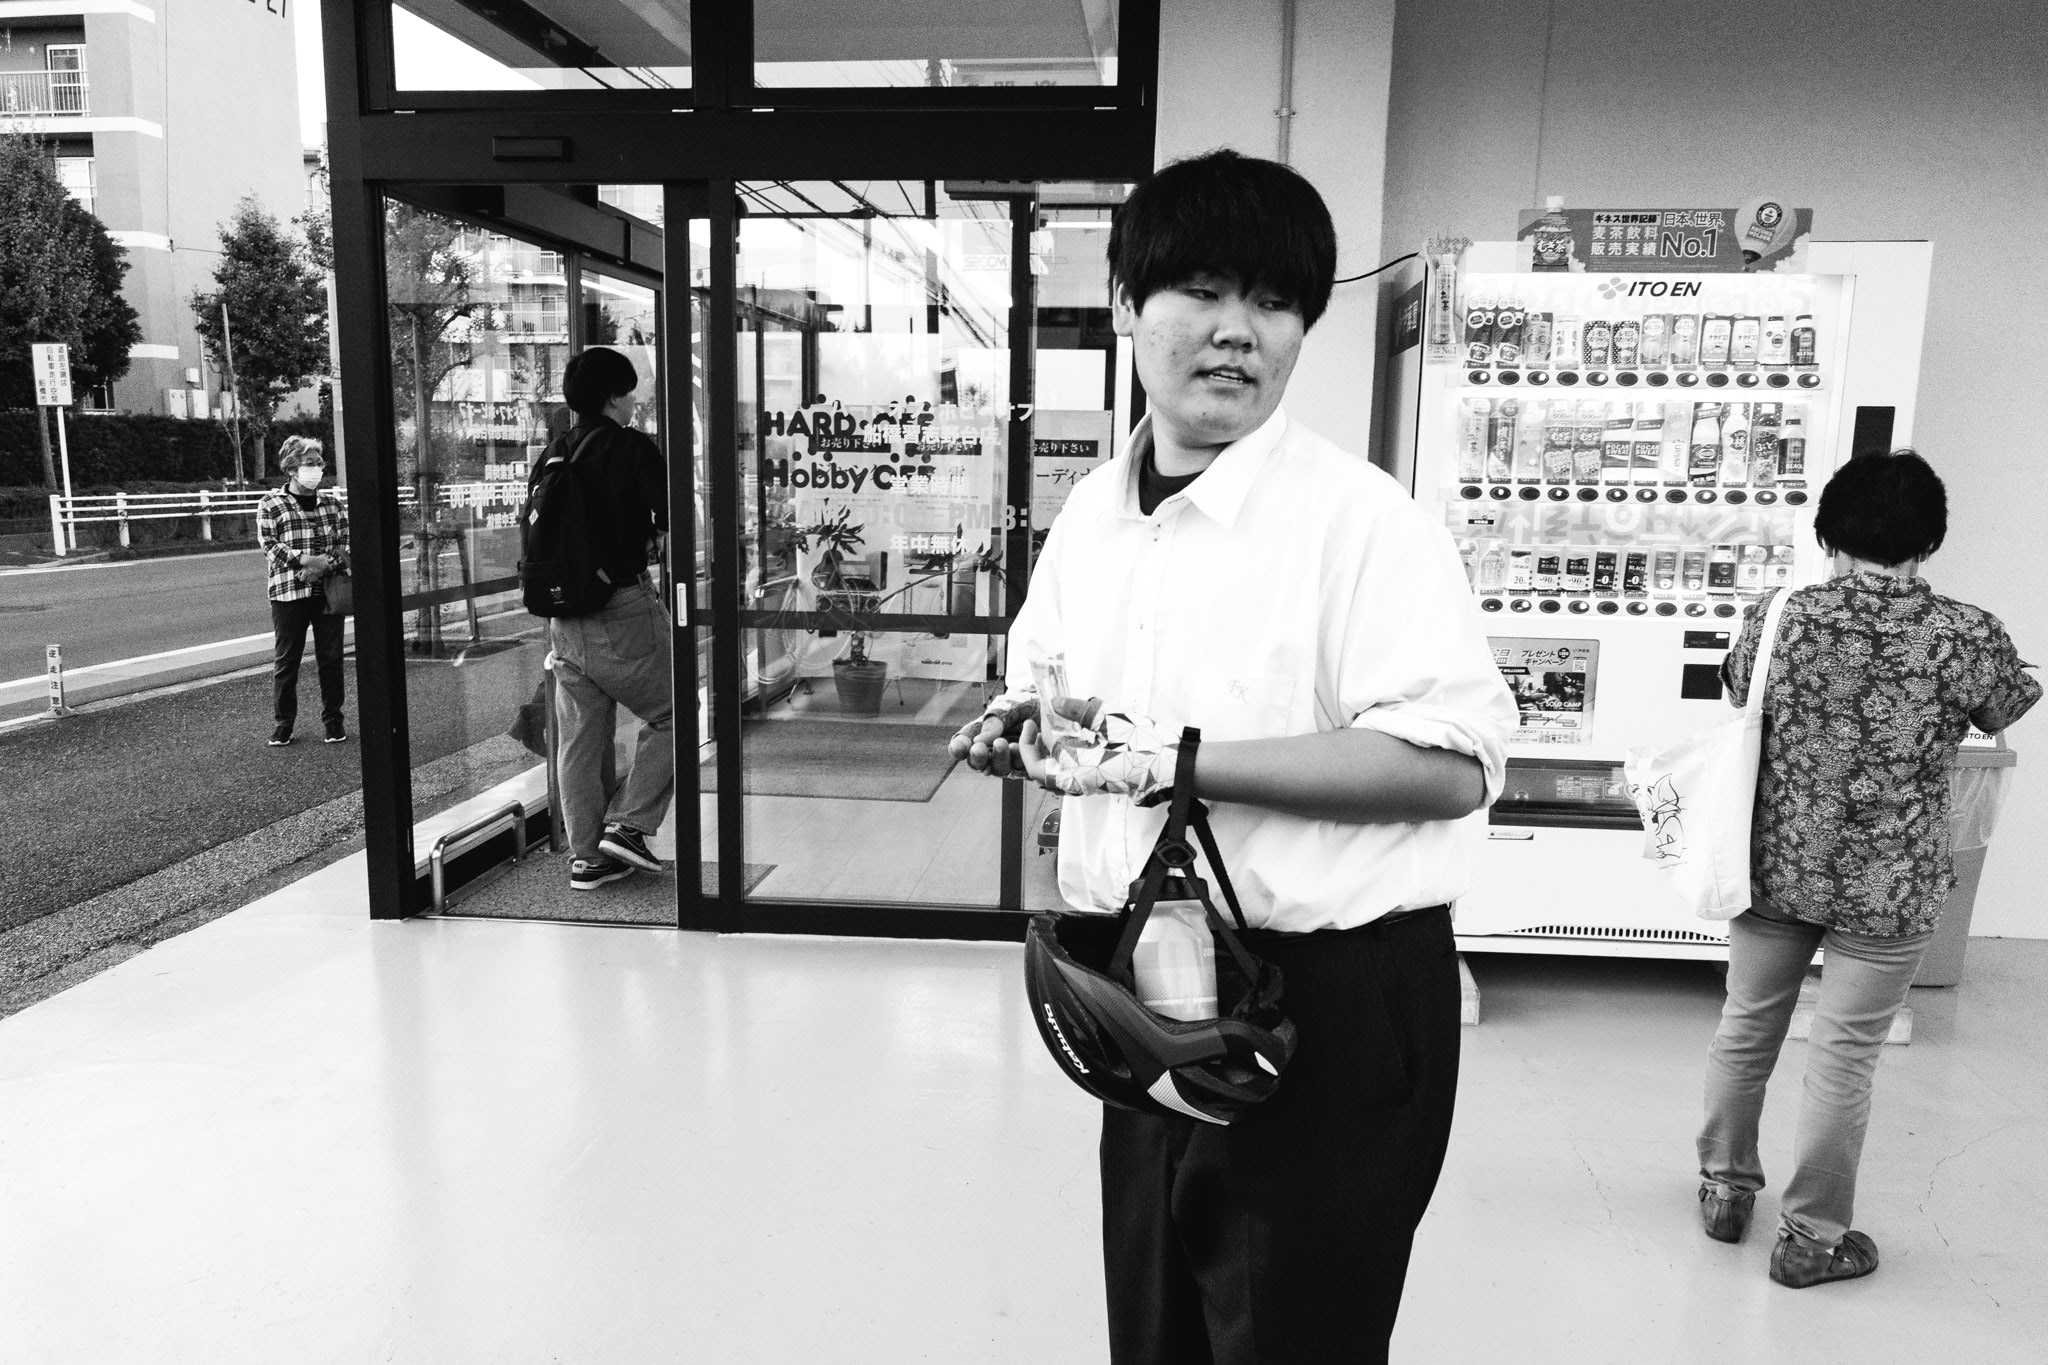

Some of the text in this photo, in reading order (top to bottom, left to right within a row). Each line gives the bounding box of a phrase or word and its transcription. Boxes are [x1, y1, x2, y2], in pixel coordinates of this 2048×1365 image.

[1595, 214, 1658, 224] ギネス世界記録
[1592, 226, 1659, 240] 麦茶飲料
[1590, 241, 1658, 256] 販売実績
[1660, 228, 1718, 258] No.1
[1627, 281, 1703, 297] ITO EN
[889, 534, 971, 555] 年中無休
[1521, 650, 1556, 658] プレゼント
[1524, 658, 1567, 666] キャンペーン
[1044, 1003, 1090, 1074] Kabuto
